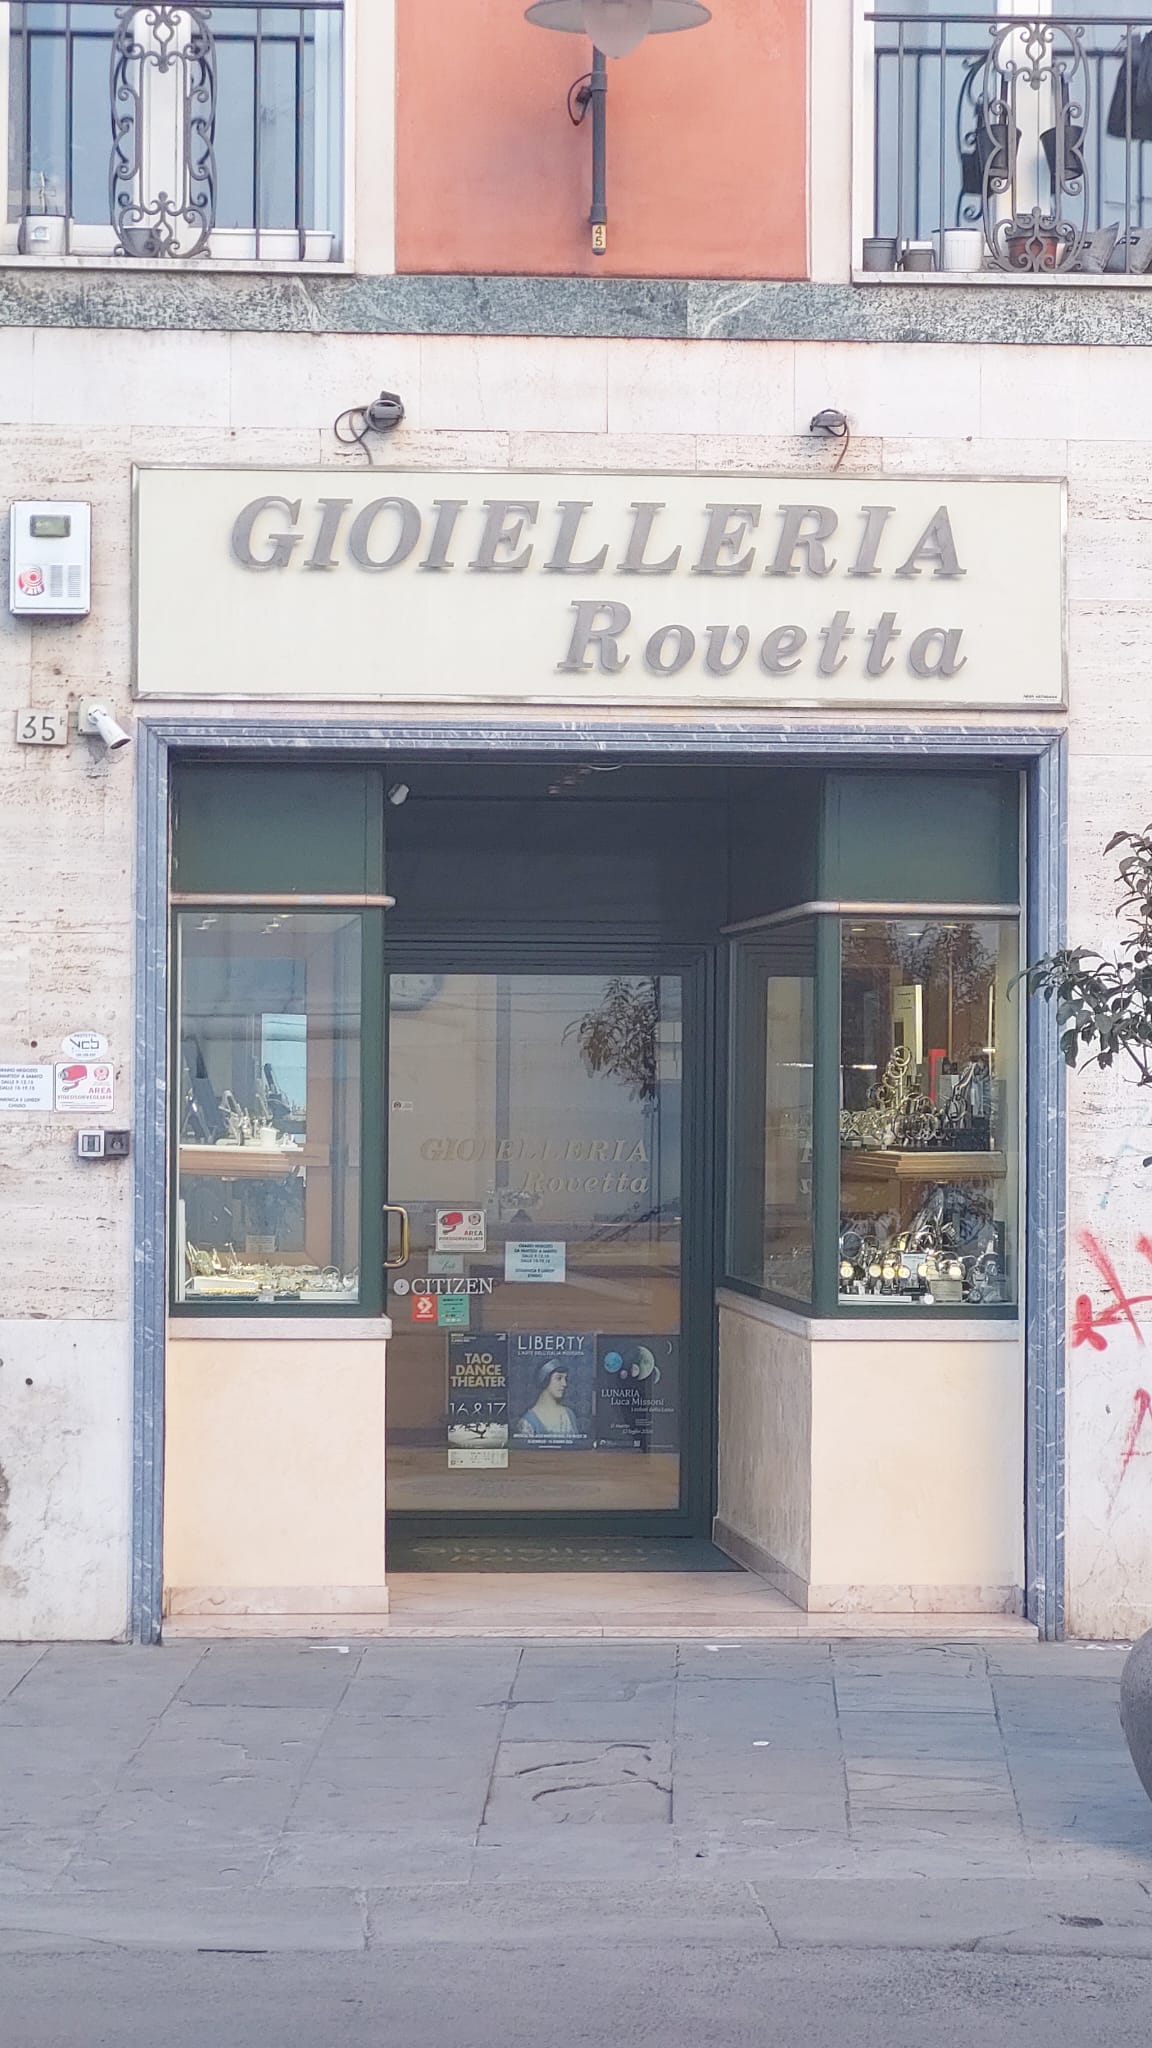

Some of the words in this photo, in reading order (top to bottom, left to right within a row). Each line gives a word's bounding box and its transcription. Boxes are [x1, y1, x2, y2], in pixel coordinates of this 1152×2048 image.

[231, 495, 968, 576] GIOIELLERIA
[556, 599, 968, 677] Rovetta
[22, 715, 56, 742] 35
[522, 1168, 649, 1193] Rovetta
[411, 1277, 494, 1295] CITIZEN
[518, 1335, 585, 1350] LIBERTY
[464, 1352, 493, 1364] TAO
[455, 1364, 502, 1376] DANCE
[450, 1376, 506, 1388] THEATER
[601, 1389, 640, 1398] LUNARIA
[611, 1397, 630, 1406] Luca
[632, 1397, 664, 1406] Missoni
